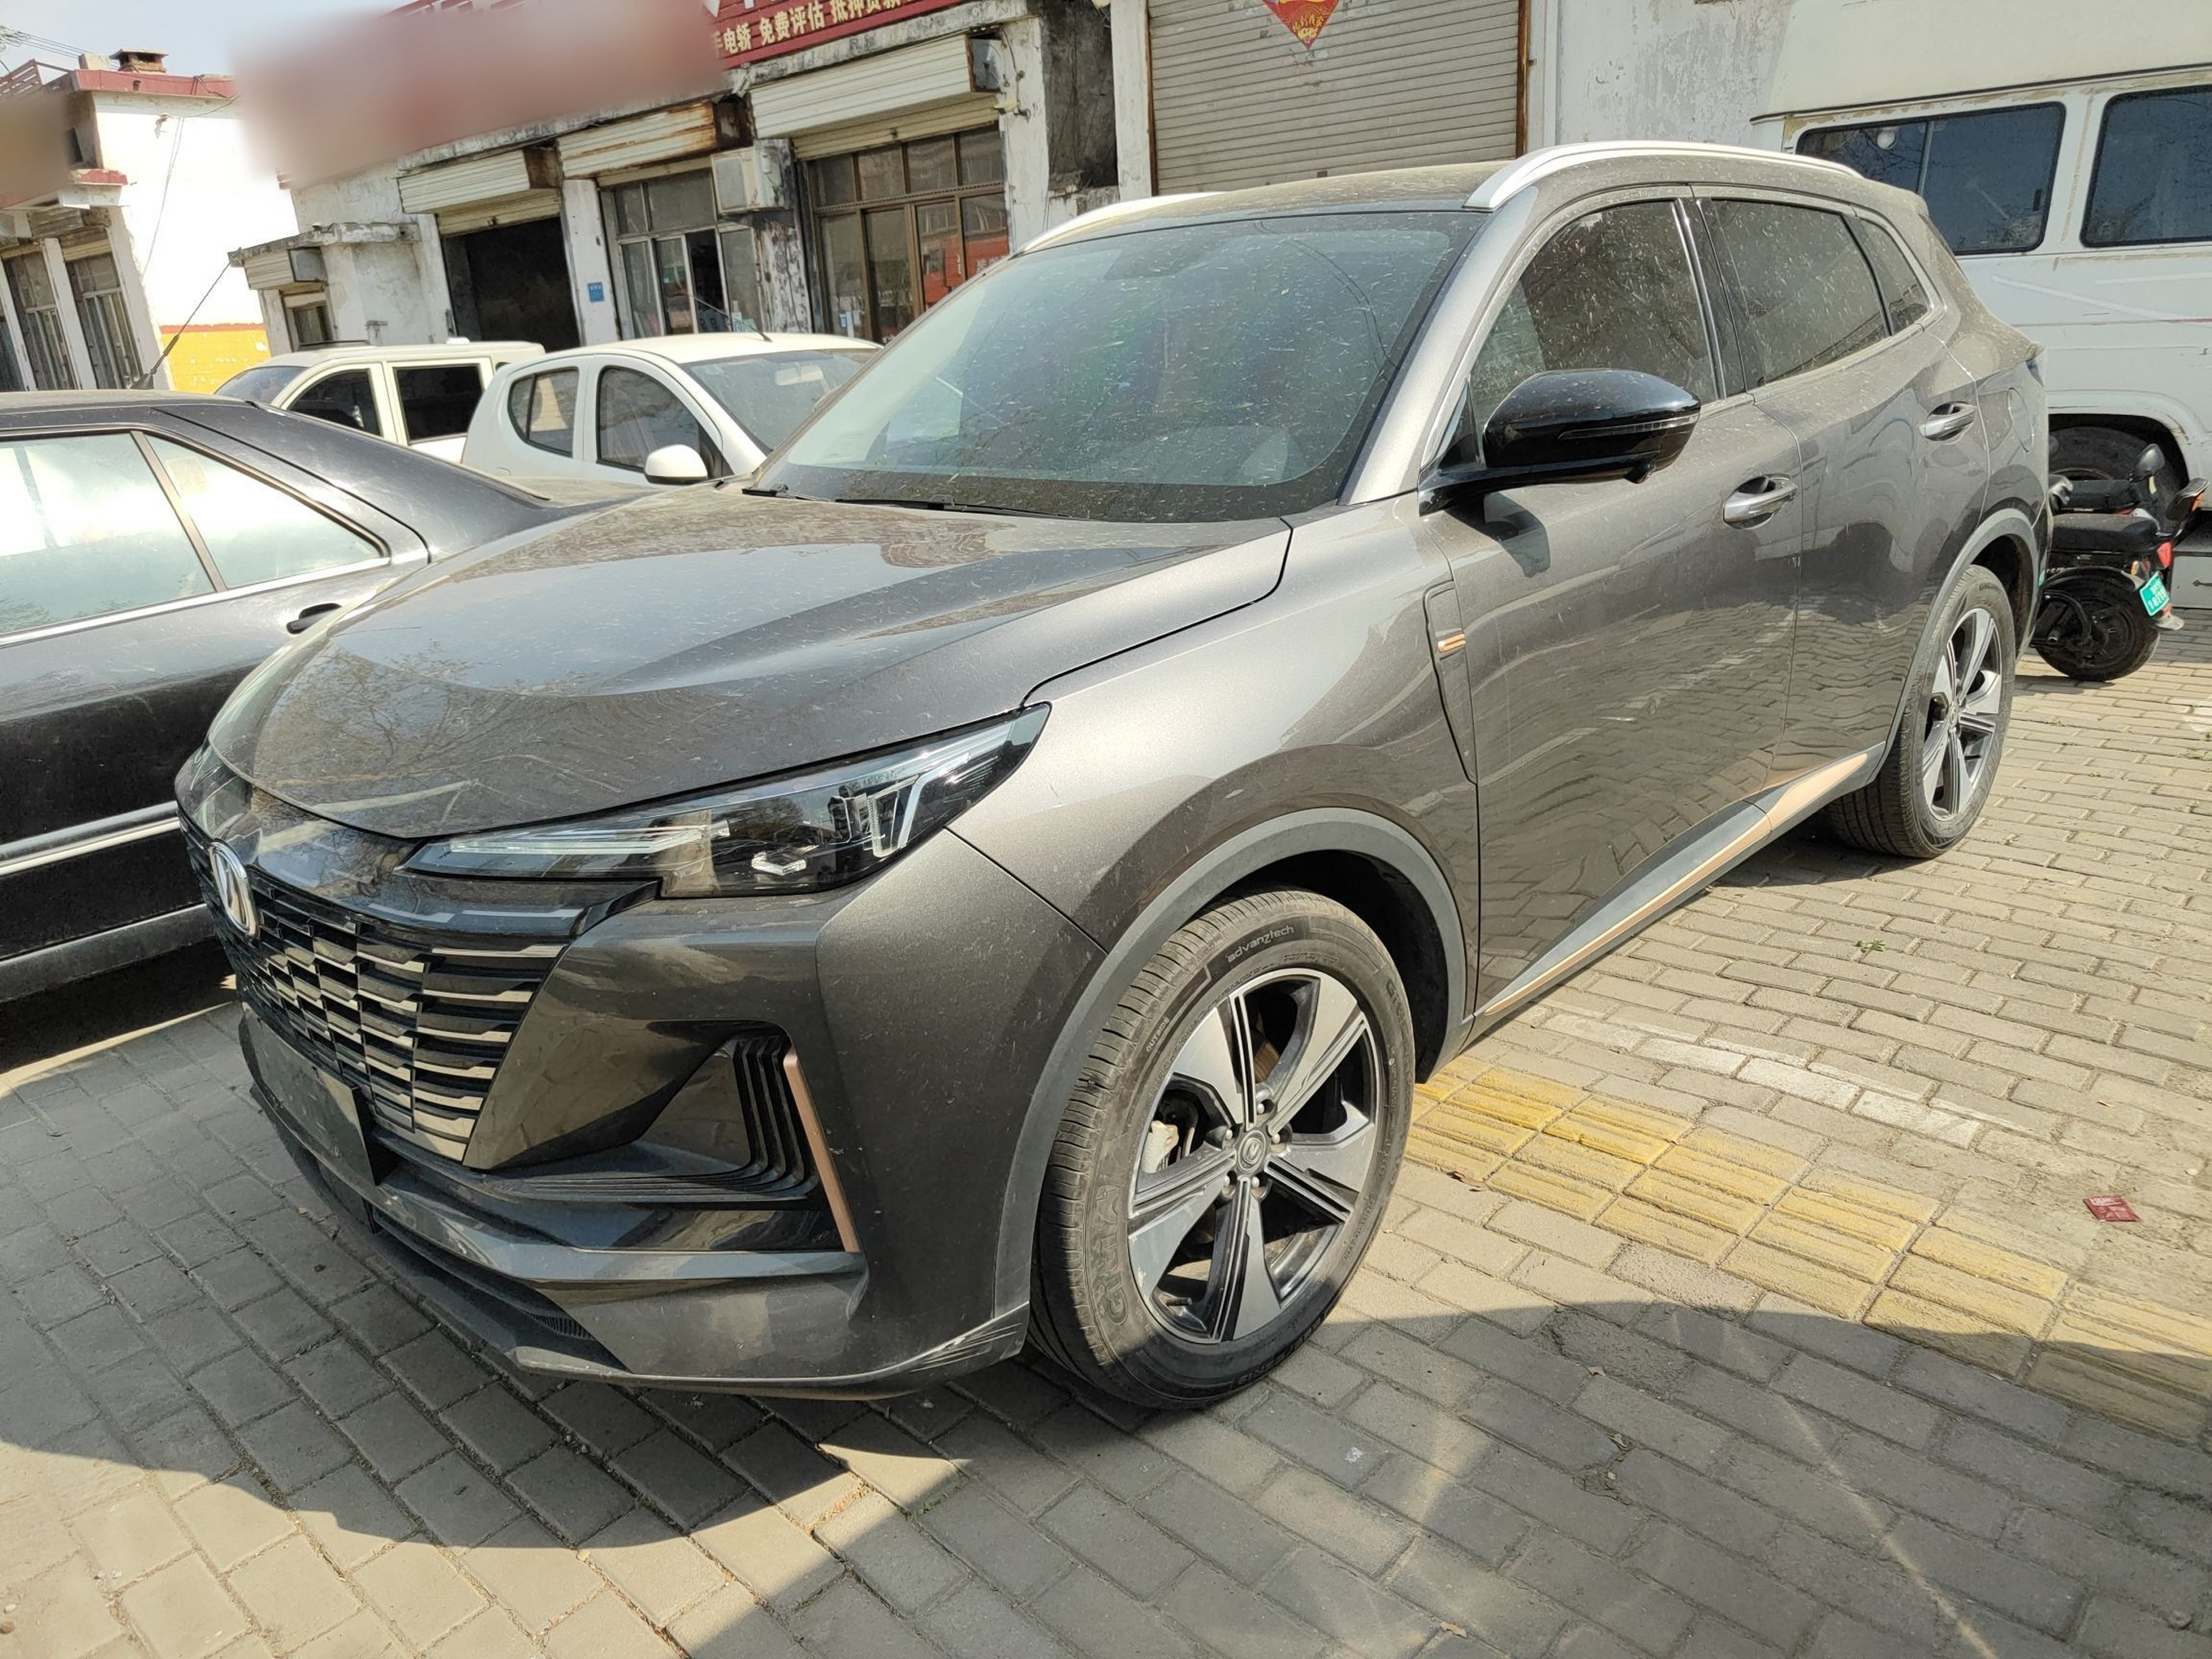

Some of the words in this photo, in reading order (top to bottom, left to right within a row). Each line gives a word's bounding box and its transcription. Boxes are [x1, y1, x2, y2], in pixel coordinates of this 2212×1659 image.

[759, 1, 825, 46] 免费评估
[830, 0, 901, 24] 抵押
[1228, 925, 1294, 963] advanztech
